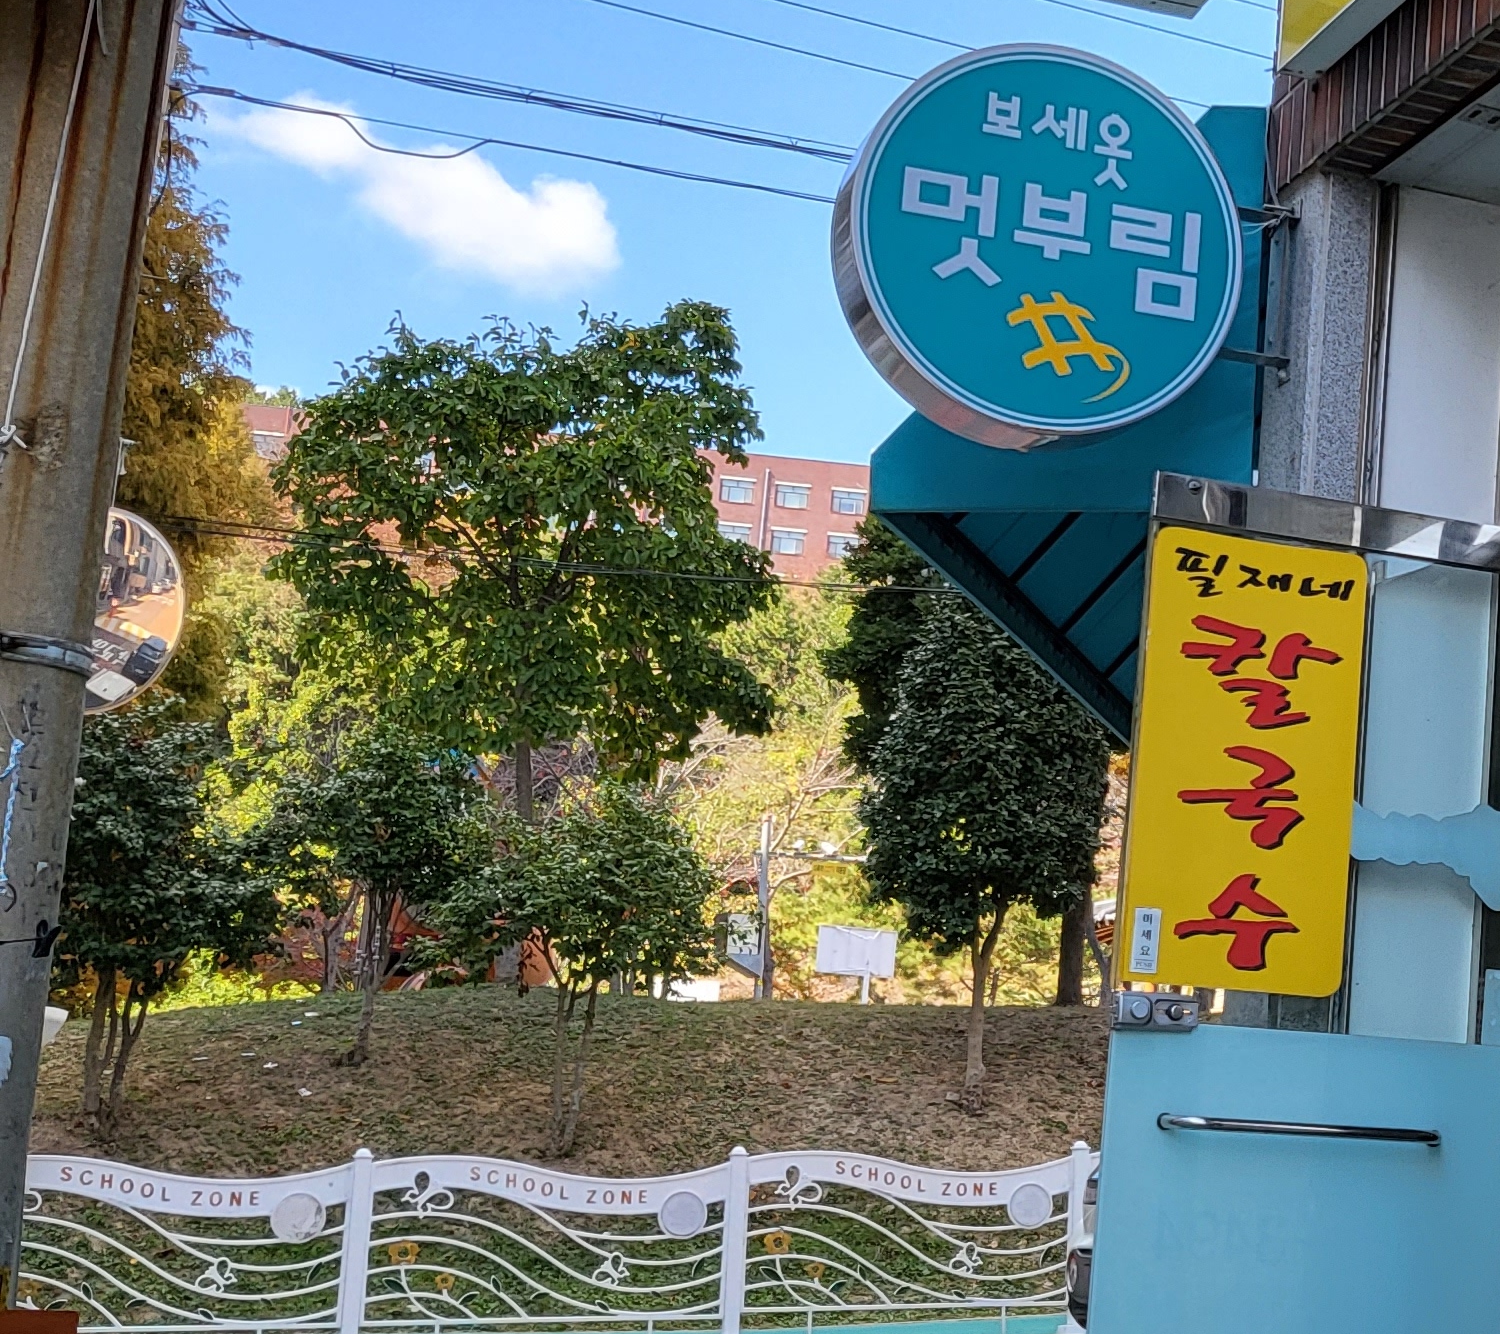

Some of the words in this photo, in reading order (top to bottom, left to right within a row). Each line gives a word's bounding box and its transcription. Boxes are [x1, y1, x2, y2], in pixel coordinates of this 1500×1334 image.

[982, 91, 1133, 191] 보세옷
[901, 165, 1202, 321] 멋부림
[1175, 546, 1355, 602] 필재네
[1173, 615, 1344, 972] 칼국수
[1139, 913, 1153, 956] 미세요
[60, 1166, 171, 1202] SCHOOL
[191, 1190, 261, 1207] ZONE
[469, 1166, 569, 1201] SCHOOL
[586, 1189, 648, 1205] ZONE
[835, 1160, 927, 1193] SCHOOL
[941, 1181, 998, 1197] ZONE
